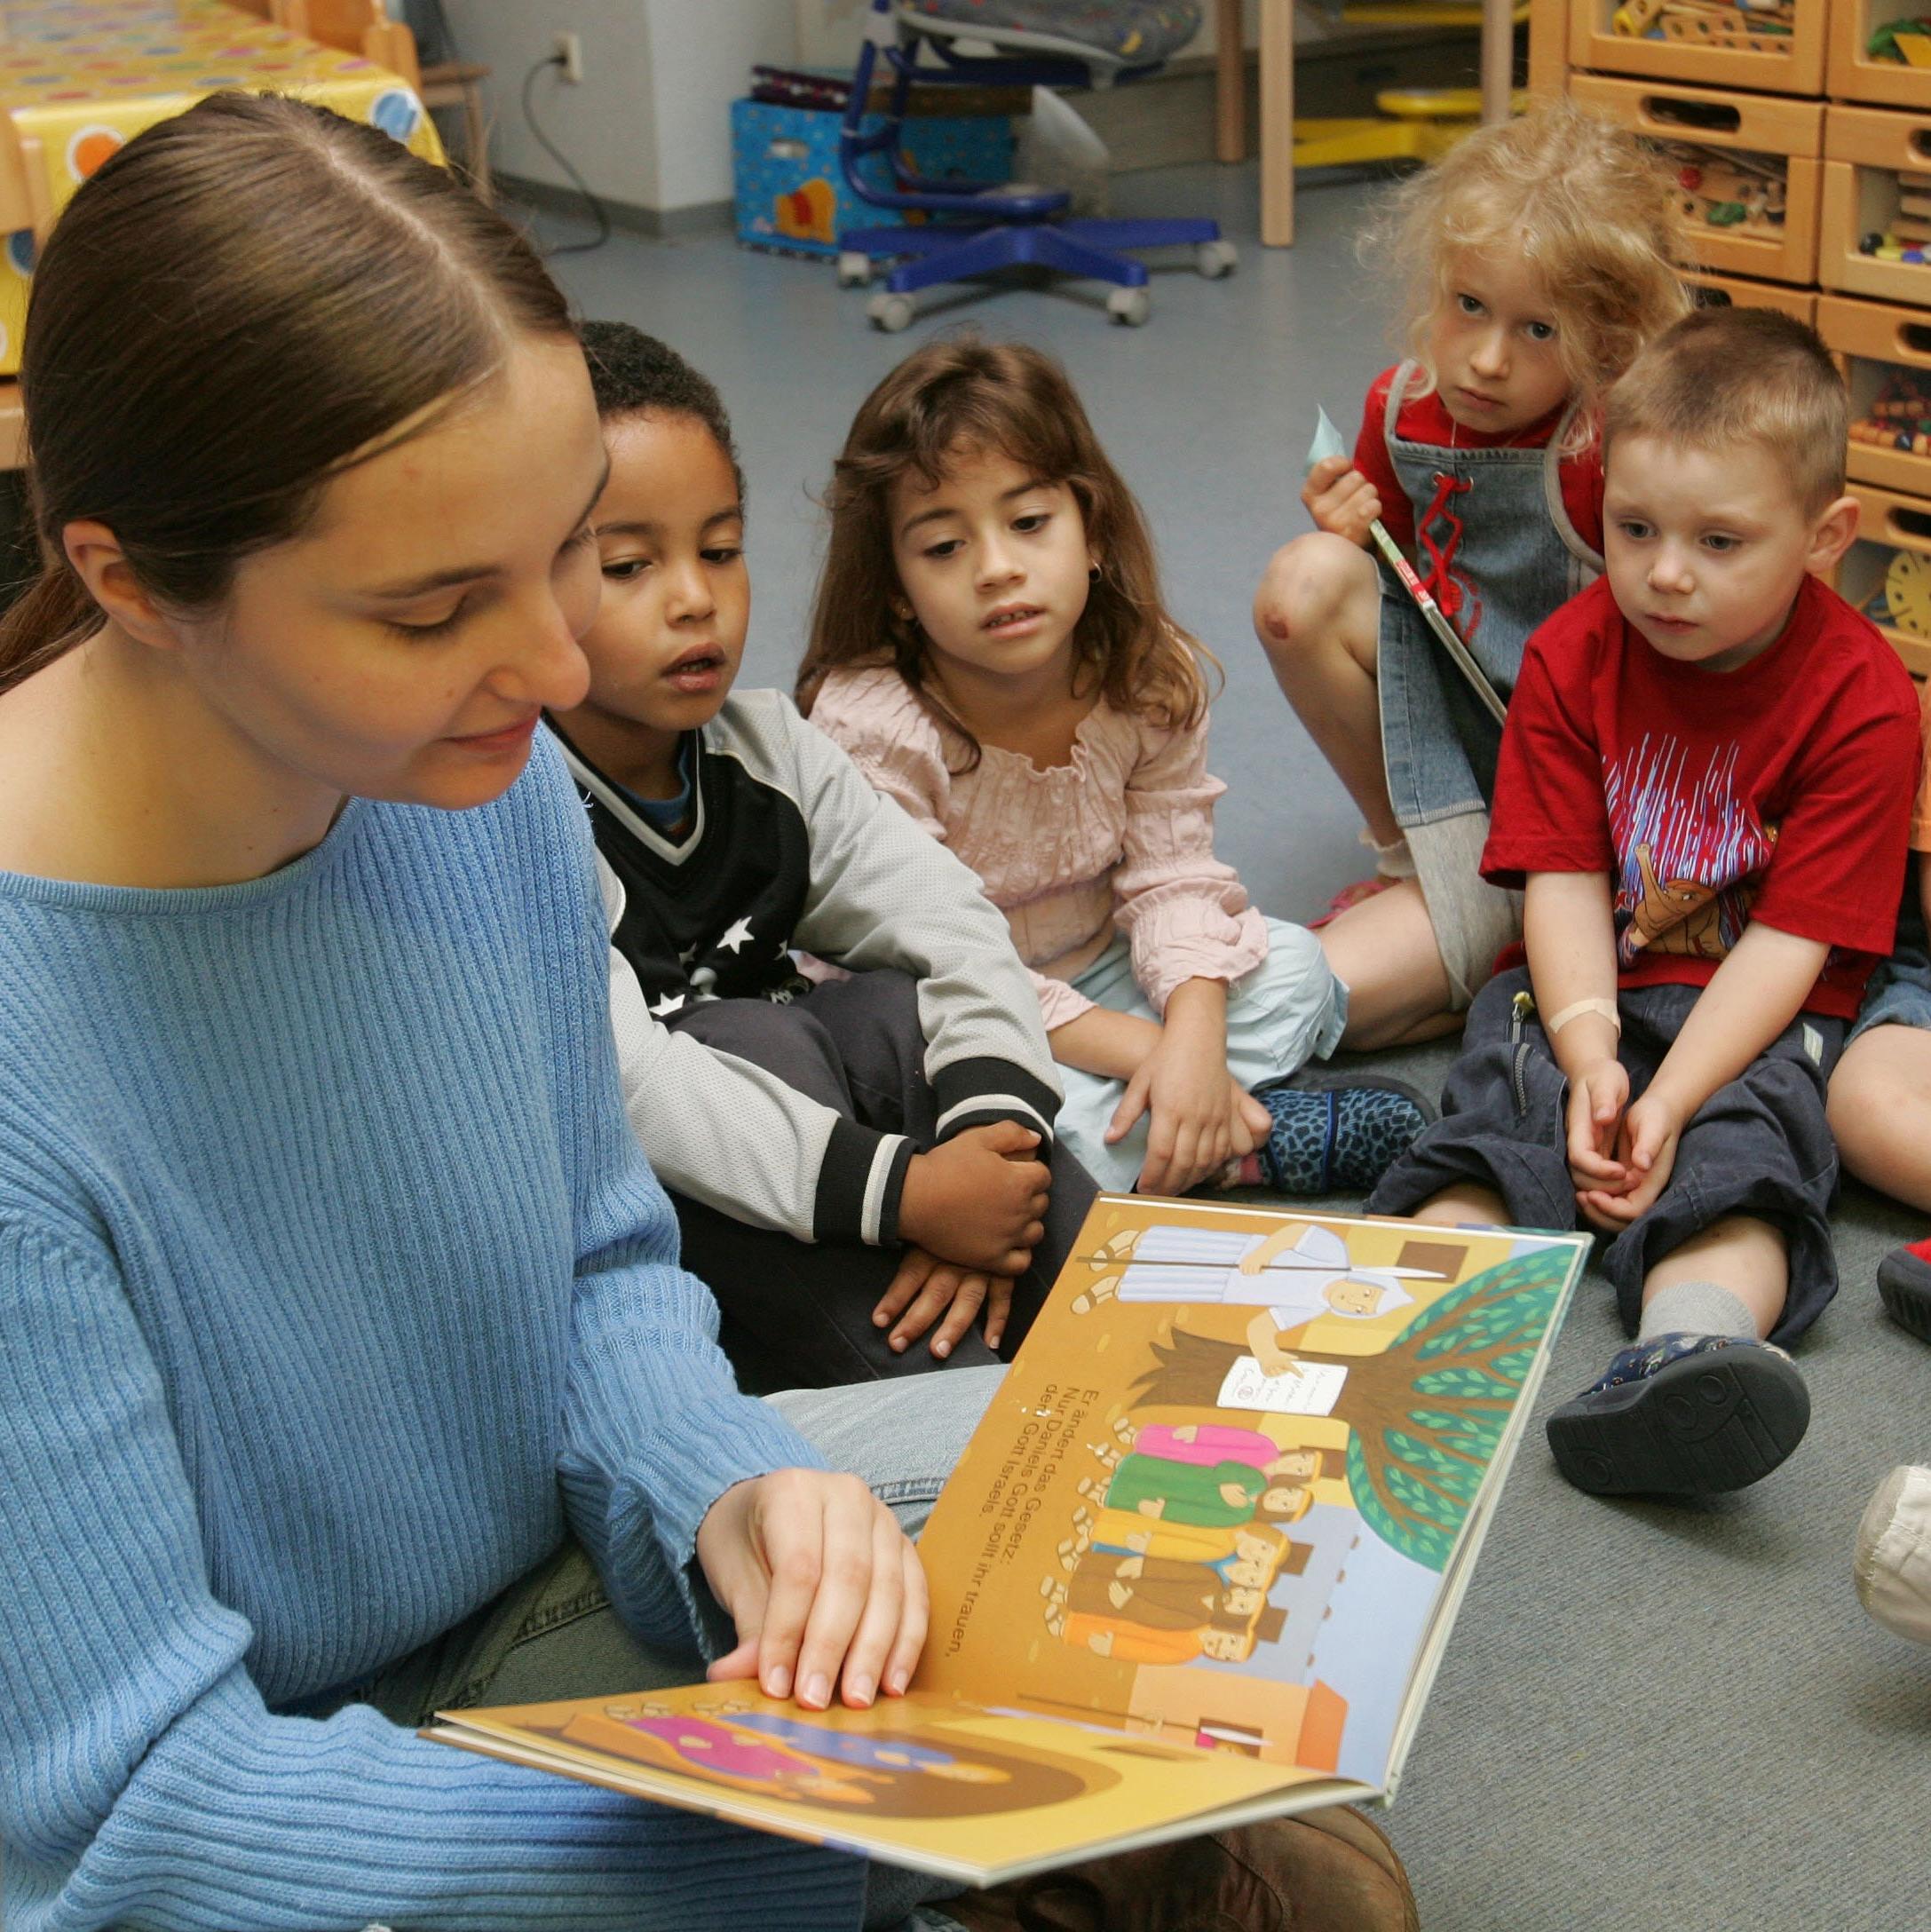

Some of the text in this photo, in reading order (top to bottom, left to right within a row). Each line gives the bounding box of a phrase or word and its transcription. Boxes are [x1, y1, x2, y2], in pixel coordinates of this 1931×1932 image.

[978, 1461, 1020, 1517] Israels.
[1001, 1390, 1099, 1564] Er ändert das Gesetz:
[1010, 1423, 1039, 1456] Gott
[946, 1387, 1080, 1658] Nur Daniels Gott sollt ihr trauen,
